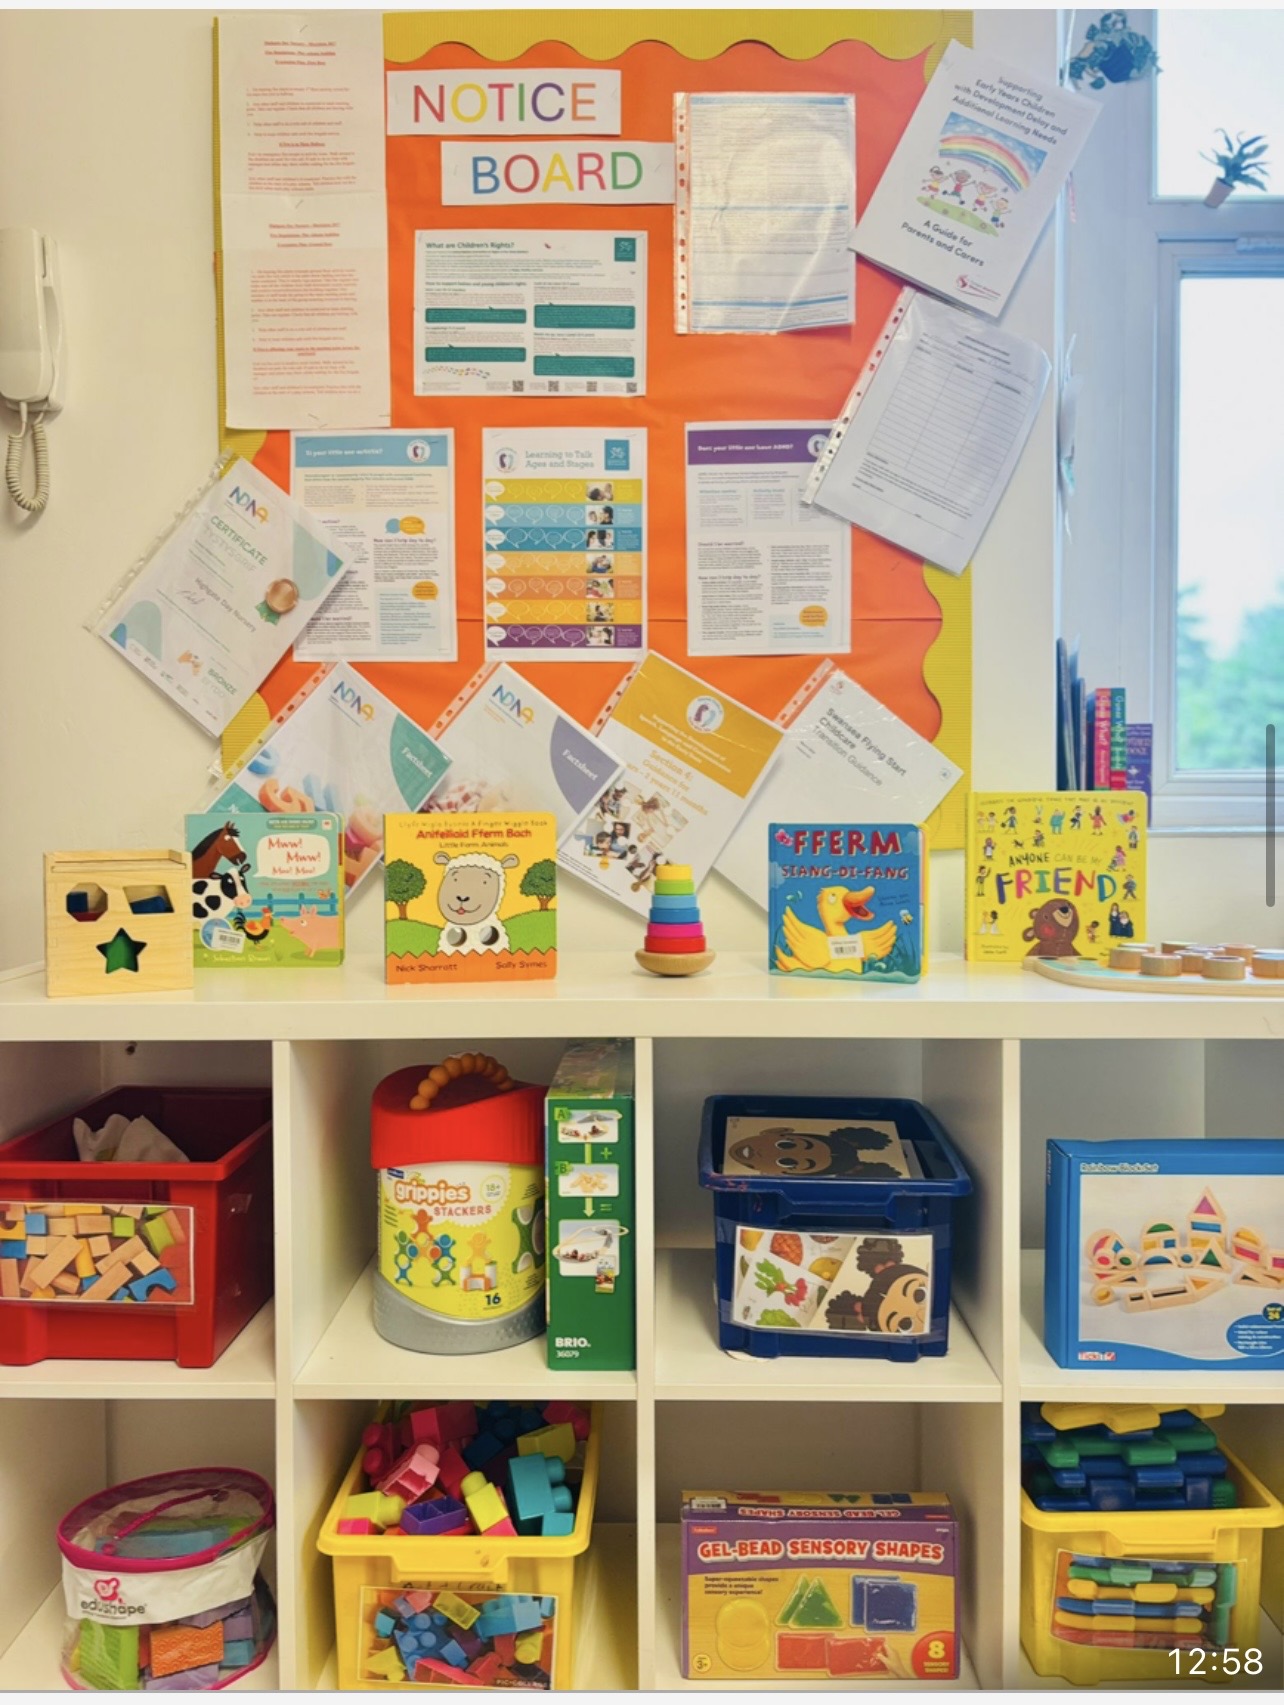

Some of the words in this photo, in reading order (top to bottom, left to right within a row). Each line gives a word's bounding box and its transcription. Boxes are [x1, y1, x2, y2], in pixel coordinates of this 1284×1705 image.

[413, 82, 597, 123] NOTICE
[975, 80, 996, 94] Early
[998, 89, 1020, 102] Years
[1020, 98, 1056, 118] Children
[997, 77, 1043, 101] Supporting
[952, 95, 994, 117] Additional
[995, 113, 1031, 134] Learning
[1032, 129, 1057, 144] Needs
[954, 83, 971, 94] with
[972, 91, 1026, 118] Development
[1026, 113, 1050, 129] Delay
[1050, 123, 1067, 135] and
[472, 151, 643, 194] BOARD
[901, 221, 935, 245] Parents
[935, 238, 953, 253] and
[954, 247, 985, 268] Carers
[923, 220, 932, 229] A
[931, 222, 957, 243] Guide
[957, 233, 974, 249] for
[525, 450, 563, 460] Learning
[565, 451, 573, 459] to
[575, 450, 593, 459] Talk
[525, 460, 548, 470] Ages
[549, 459, 564, 468] and
[566, 459, 594, 470] Stages
[229, 485, 269, 524] NDNA
[210, 515, 268, 565] CERTIFICATE
[194, 577, 221, 602] Highgate
[220, 599, 234, 613] Day
[232, 610, 257, 633] Nursery
[207, 668, 238, 695] BRONZE
[333, 680, 375, 722] NDNA
[492, 684, 535, 725] NDNA
[818, 716, 857, 750] Childcare
[826, 707, 862, 741] Swansea
[860, 736, 887, 762] Flying
[886, 756, 907, 777] Start
[401, 746, 433, 779] Factsheet
[562, 748, 598, 782] Factsheet
[650, 751, 684, 775] Section
[812, 725, 849, 759] Transition
[847, 754, 884, 787] Guidance
[642, 759, 678, 784] Guidance
[678, 781, 690, 791] for
[650, 777, 671, 793] years
[680, 795, 709, 815] months
[267, 837, 303, 851] Mww!
[471, 829, 505, 839] Fferm
[506, 828, 532, 838] Bach
[793, 829, 903, 856] FFERM
[286, 851, 321, 864] Mww!
[1008, 852, 1050, 868] ANYONE
[1054, 853, 1074, 864] CAN
[1076, 854, 1088, 864] BE
[781, 865, 909, 880] SIANG-DI-FANG
[995, 866, 1117, 905] FRIEND
[395, 964, 416, 973] Nick
[417, 963, 458, 972] Sharratt
[495, 961, 517, 970] Sally
[519, 961, 548, 969] Symes
[557, 1110, 566, 1120] A
[559, 1163, 567, 1174] B
[395, 1179, 470, 1206] grippies
[434, 1205, 492, 1217] STACKERS
[485, 1293, 502, 1306] 16
[738, 1508, 785, 1518] SHAPES
[788, 1509, 842, 1518] SENSORY
[699, 1539, 783, 1561] GEL-BEAD
[788, 1539, 870, 1560] SENSORY
[875, 1541, 944, 1562] SHAPES
[80, 1600, 146, 1616] edushape
[927, 1640, 946, 1659] 8
